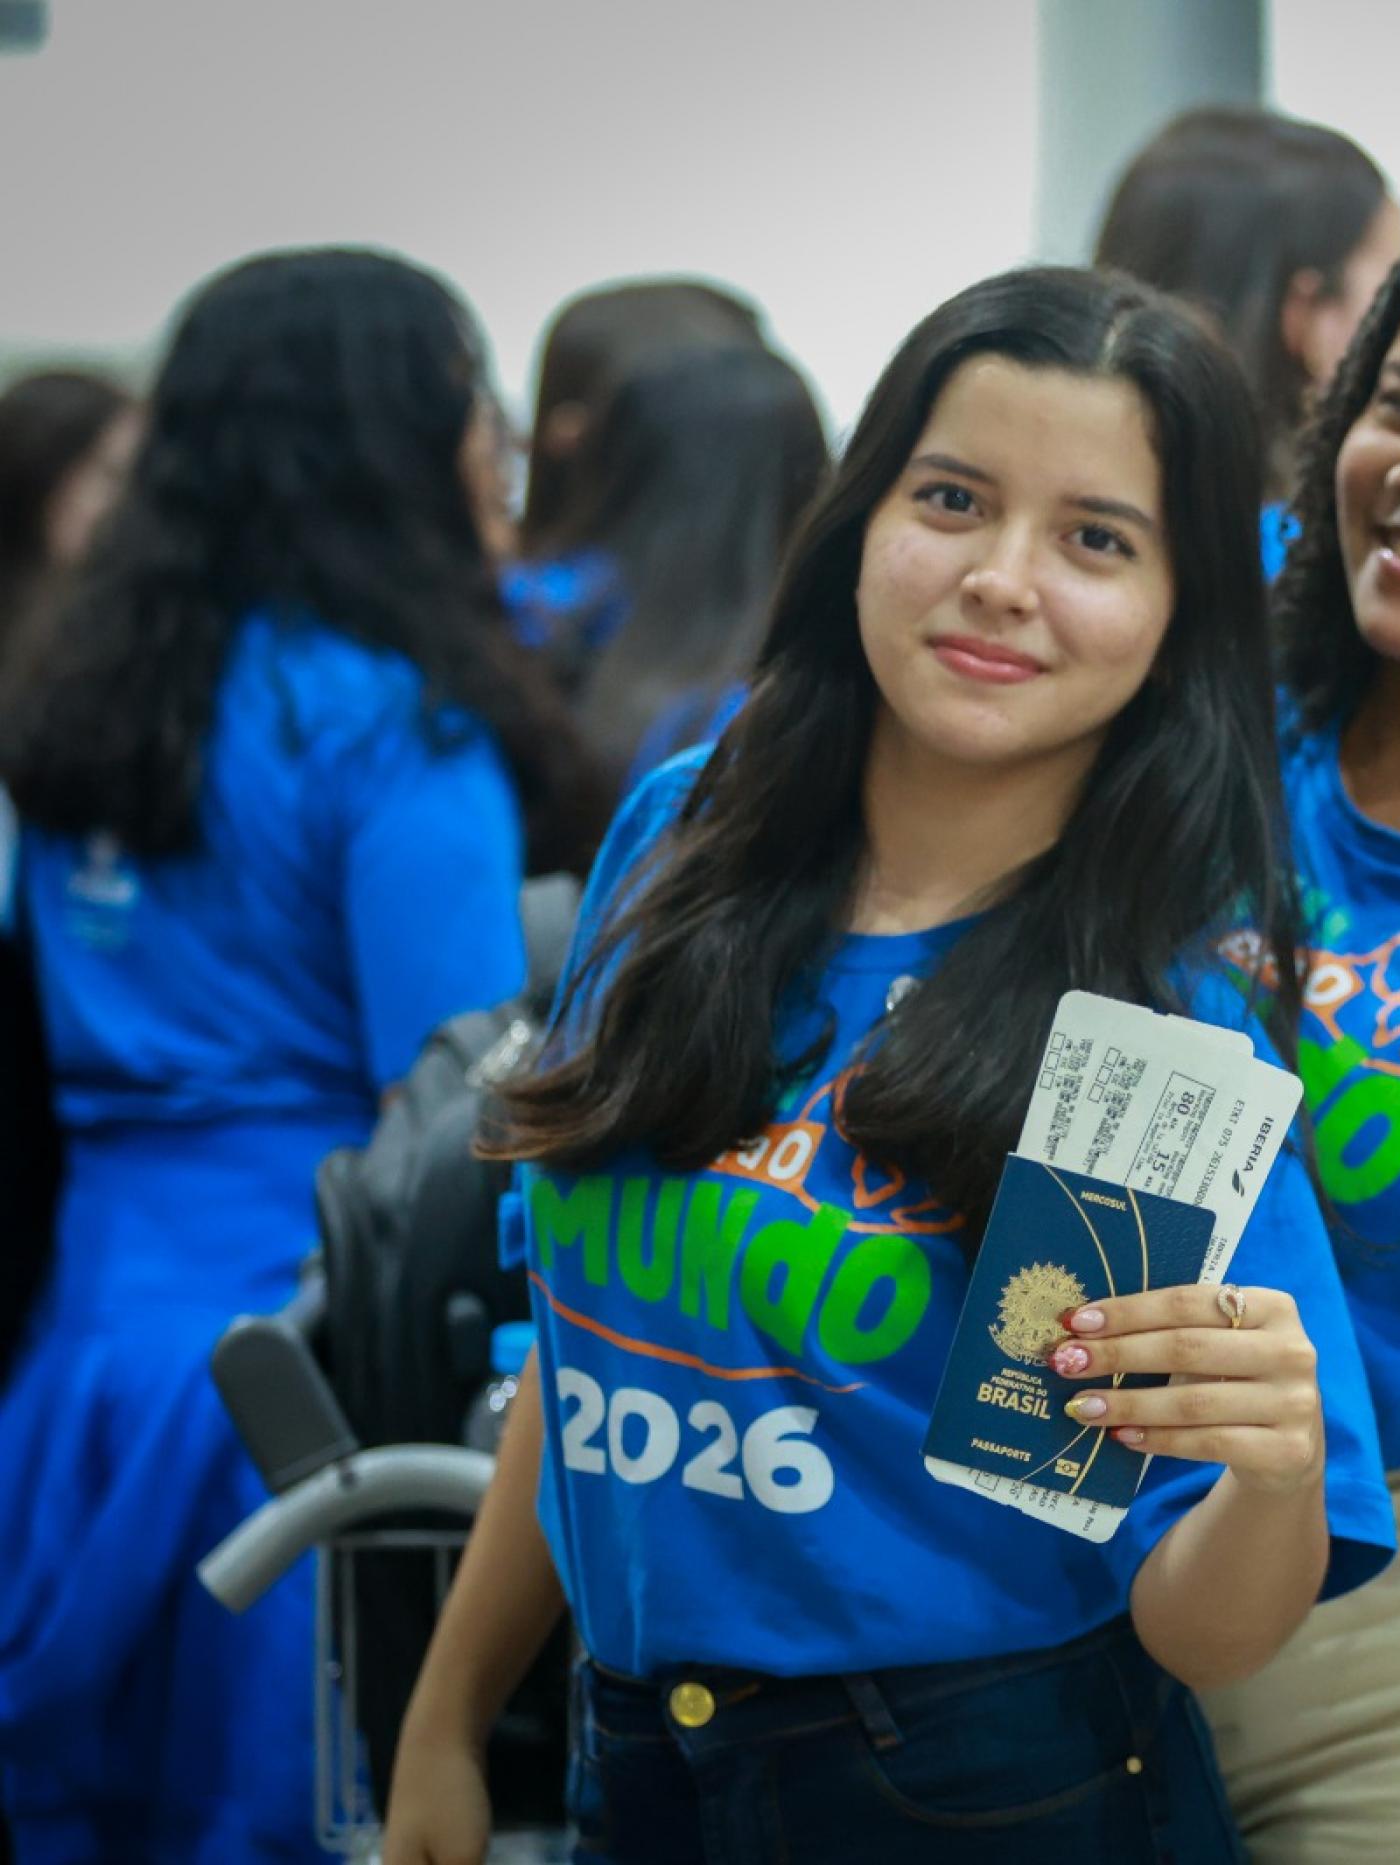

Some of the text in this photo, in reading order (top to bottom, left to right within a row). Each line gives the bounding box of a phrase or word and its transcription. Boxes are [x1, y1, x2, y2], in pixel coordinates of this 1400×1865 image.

[1177, 1091, 1195, 1115] 80
[1229, 1099, 1246, 1124] ETKT
[1218, 1128, 1233, 1147] 075
[1243, 1116, 1274, 1171] IBERIA
[1152, 1151, 1170, 1172] 15
[976, 1383, 1050, 1420] BRASIL
[556, 1366, 834, 1514] 2026
[971, 1437, 1031, 1462] PASSAPORTE
